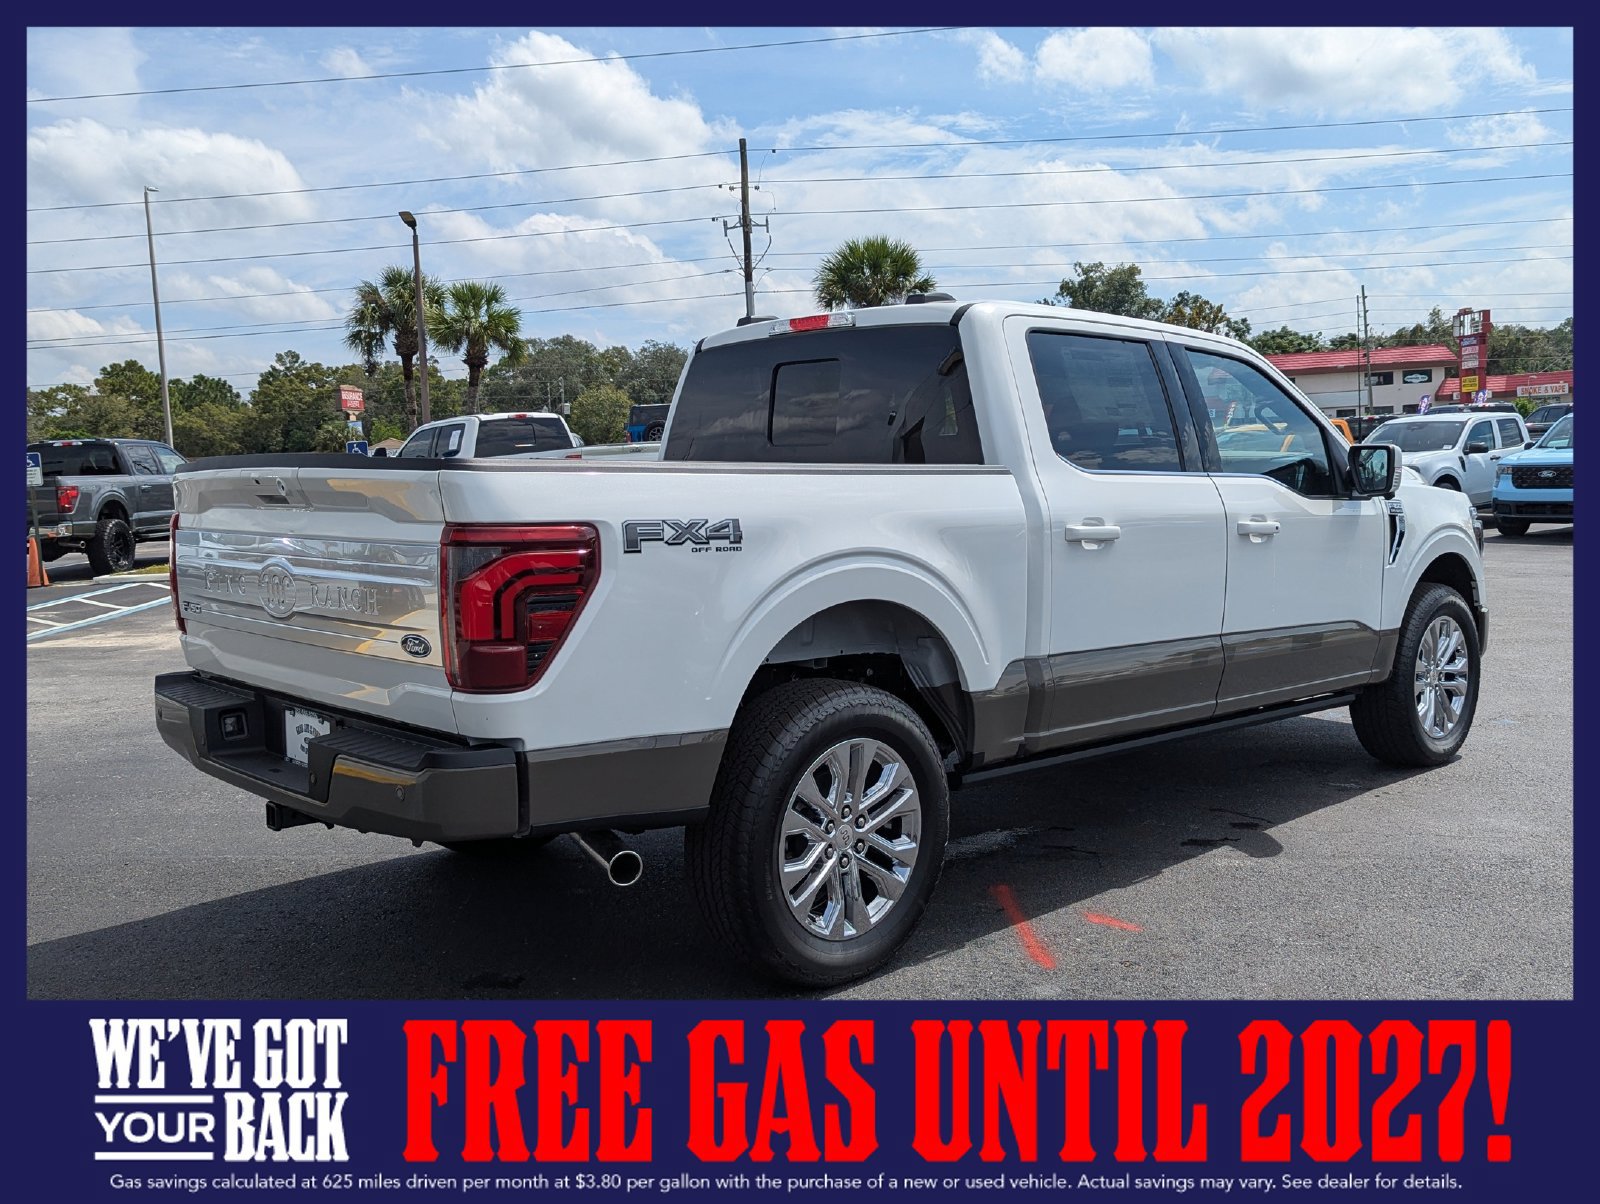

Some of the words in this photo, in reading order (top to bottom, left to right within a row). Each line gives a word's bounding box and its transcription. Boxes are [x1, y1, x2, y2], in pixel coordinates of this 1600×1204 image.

[341, 391, 363, 400] INSURANCE
[1520, 386, 1542, 395] SMOKE
[1550, 385, 1566, 393] VAPE
[622, 519, 743, 553] FX4
[203, 566, 247, 596] KING
[310, 583, 380, 616] RANCH
[403, 636, 428, 656] Ford
